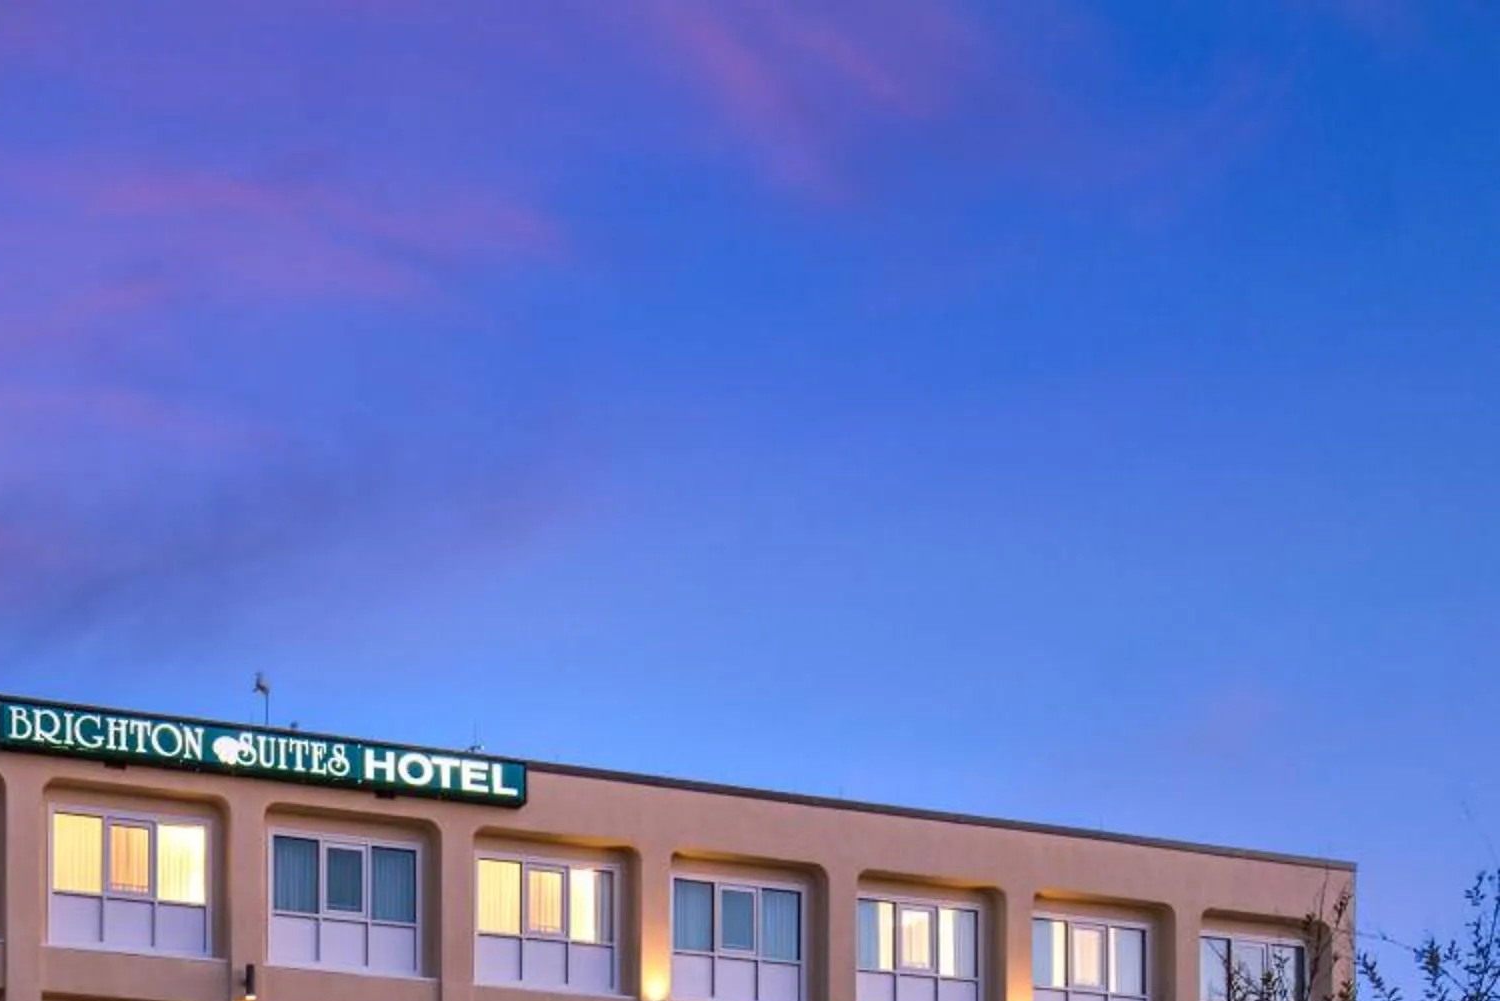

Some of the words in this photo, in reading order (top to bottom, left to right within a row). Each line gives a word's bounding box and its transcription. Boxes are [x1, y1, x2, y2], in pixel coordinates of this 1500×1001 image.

[7, 705, 204, 761] BRIGHTON
[237, 732, 351, 778] SUITES
[363, 748, 518, 797] HOTEL
